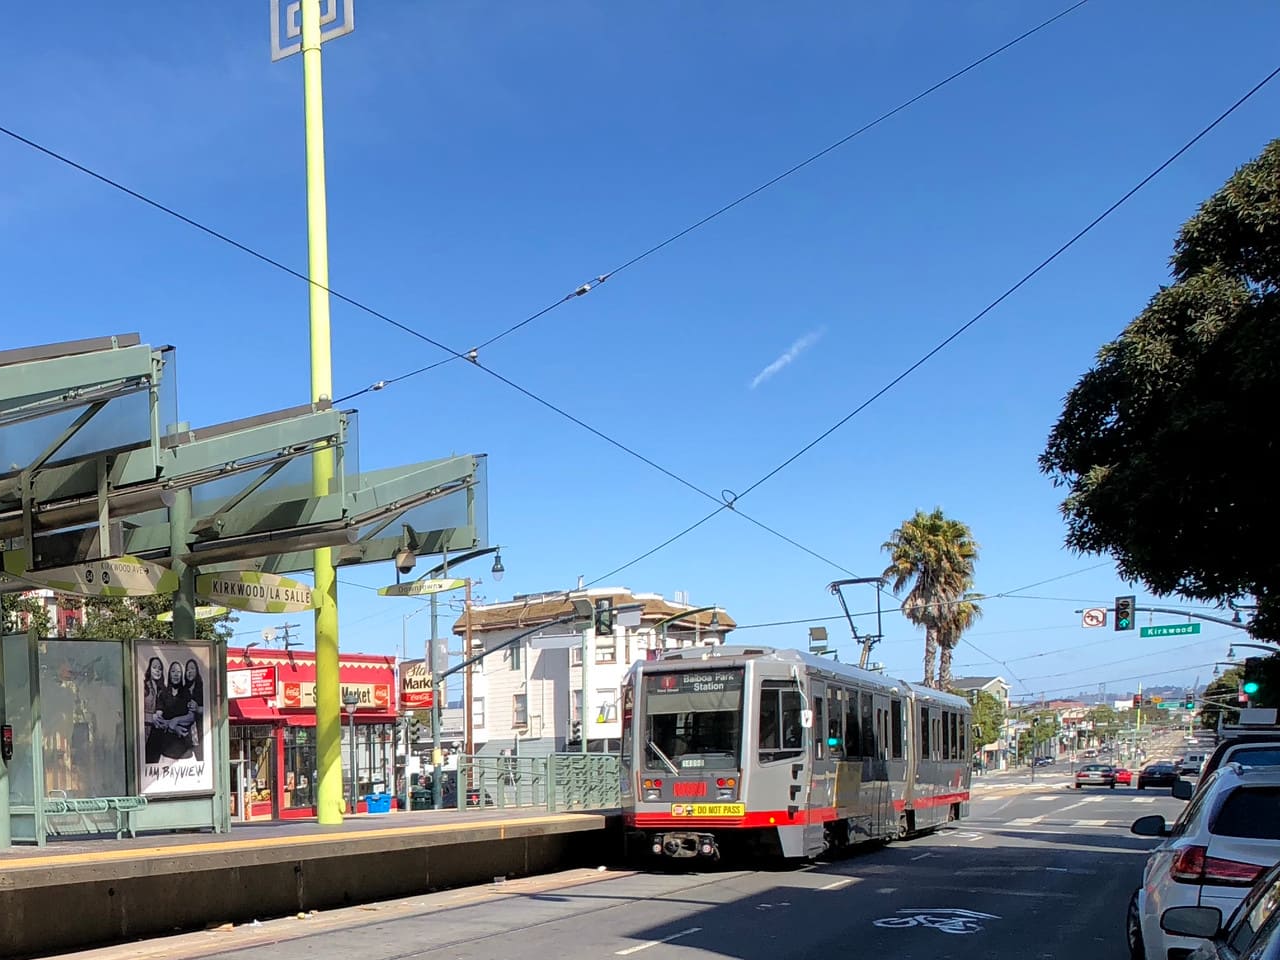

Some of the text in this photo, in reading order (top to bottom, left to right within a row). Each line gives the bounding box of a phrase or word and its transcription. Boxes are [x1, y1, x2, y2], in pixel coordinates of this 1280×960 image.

[212, 579, 311, 604] KIRKWOOD/LA SALLE
[1147, 625, 1193, 636] Kirkwood
[683, 672, 734, 683] Balboa Park
[693, 682, 724, 692] Station
[149, 765, 160, 781] AM
[162, 762, 205, 785] BAYVIEW
[697, 805, 741, 814] DO NOT PASS
